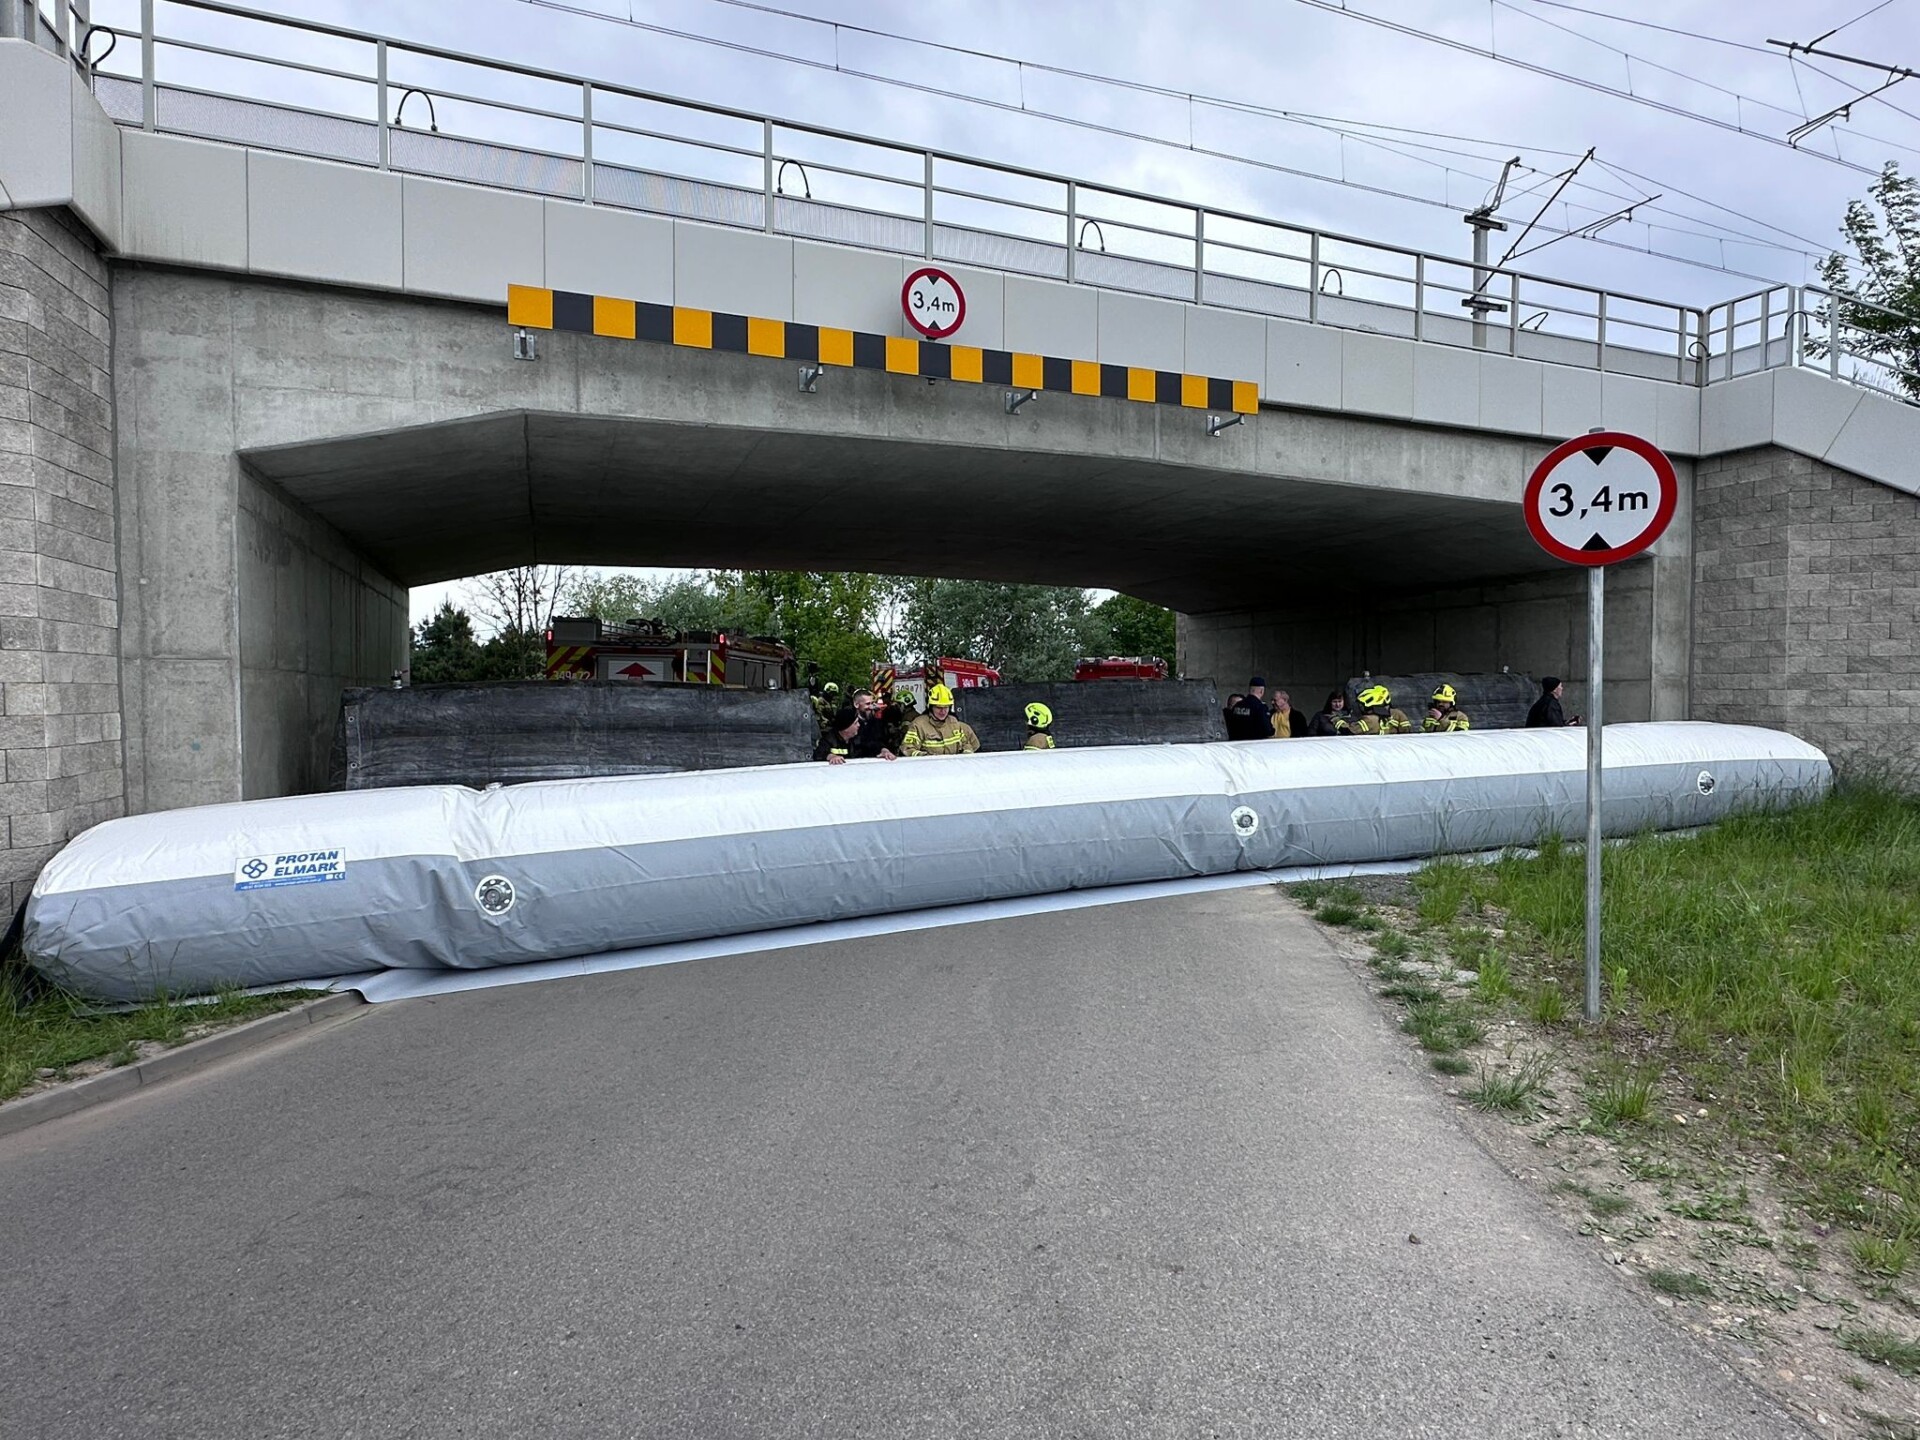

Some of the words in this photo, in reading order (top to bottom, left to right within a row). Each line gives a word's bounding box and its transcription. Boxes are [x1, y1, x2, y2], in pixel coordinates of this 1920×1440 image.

[913, 290, 955, 312] 3,4m
[1549, 483, 1648, 520] 3,4m
[275, 850, 339, 865] PROTAN
[274, 861, 340, 877] ELMARK
